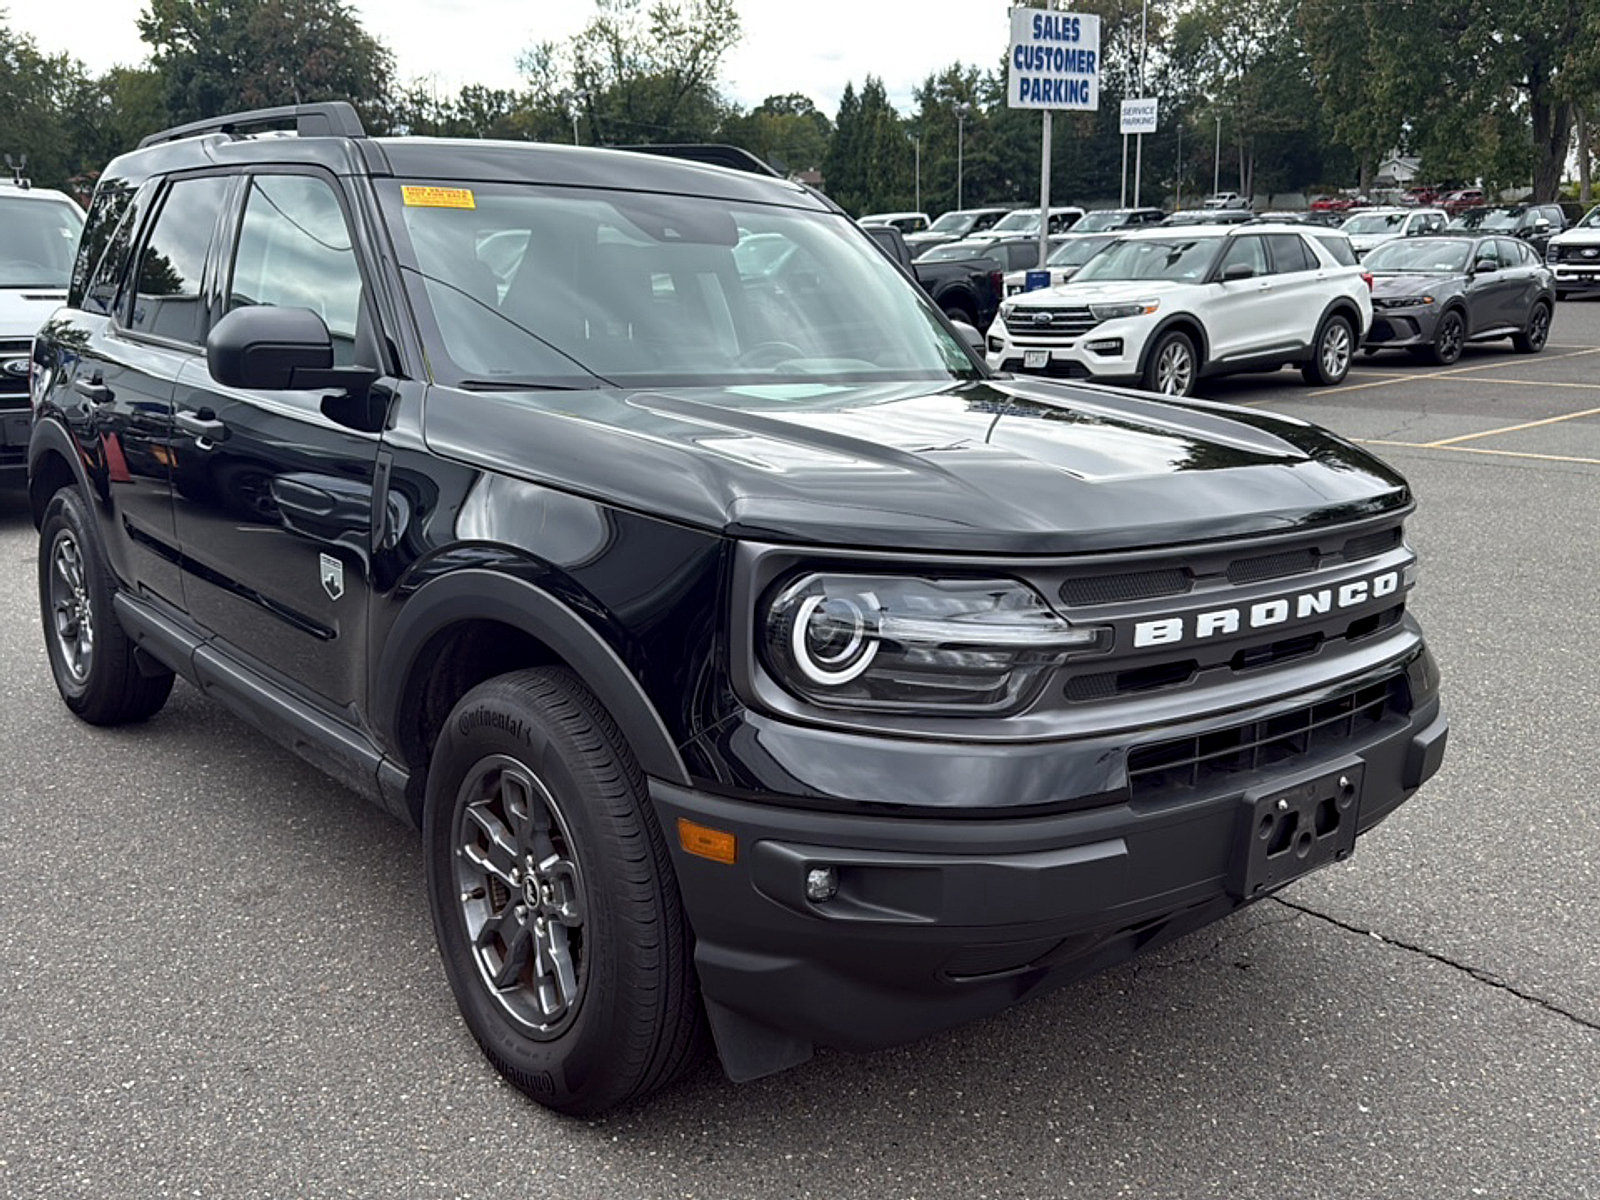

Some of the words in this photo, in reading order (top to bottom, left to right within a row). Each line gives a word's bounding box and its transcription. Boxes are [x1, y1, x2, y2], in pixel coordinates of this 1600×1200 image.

[1033, 14, 1080, 42] SALES
[1013, 45, 1096, 74] CUSTOMER
[1020, 77, 1090, 104] PARKING
[1122, 116, 1155, 126] PARKING
[1123, 106, 1155, 116] SERVICE
[1134, 572, 1398, 647] BRONCO
[459, 705, 523, 739] Continental
